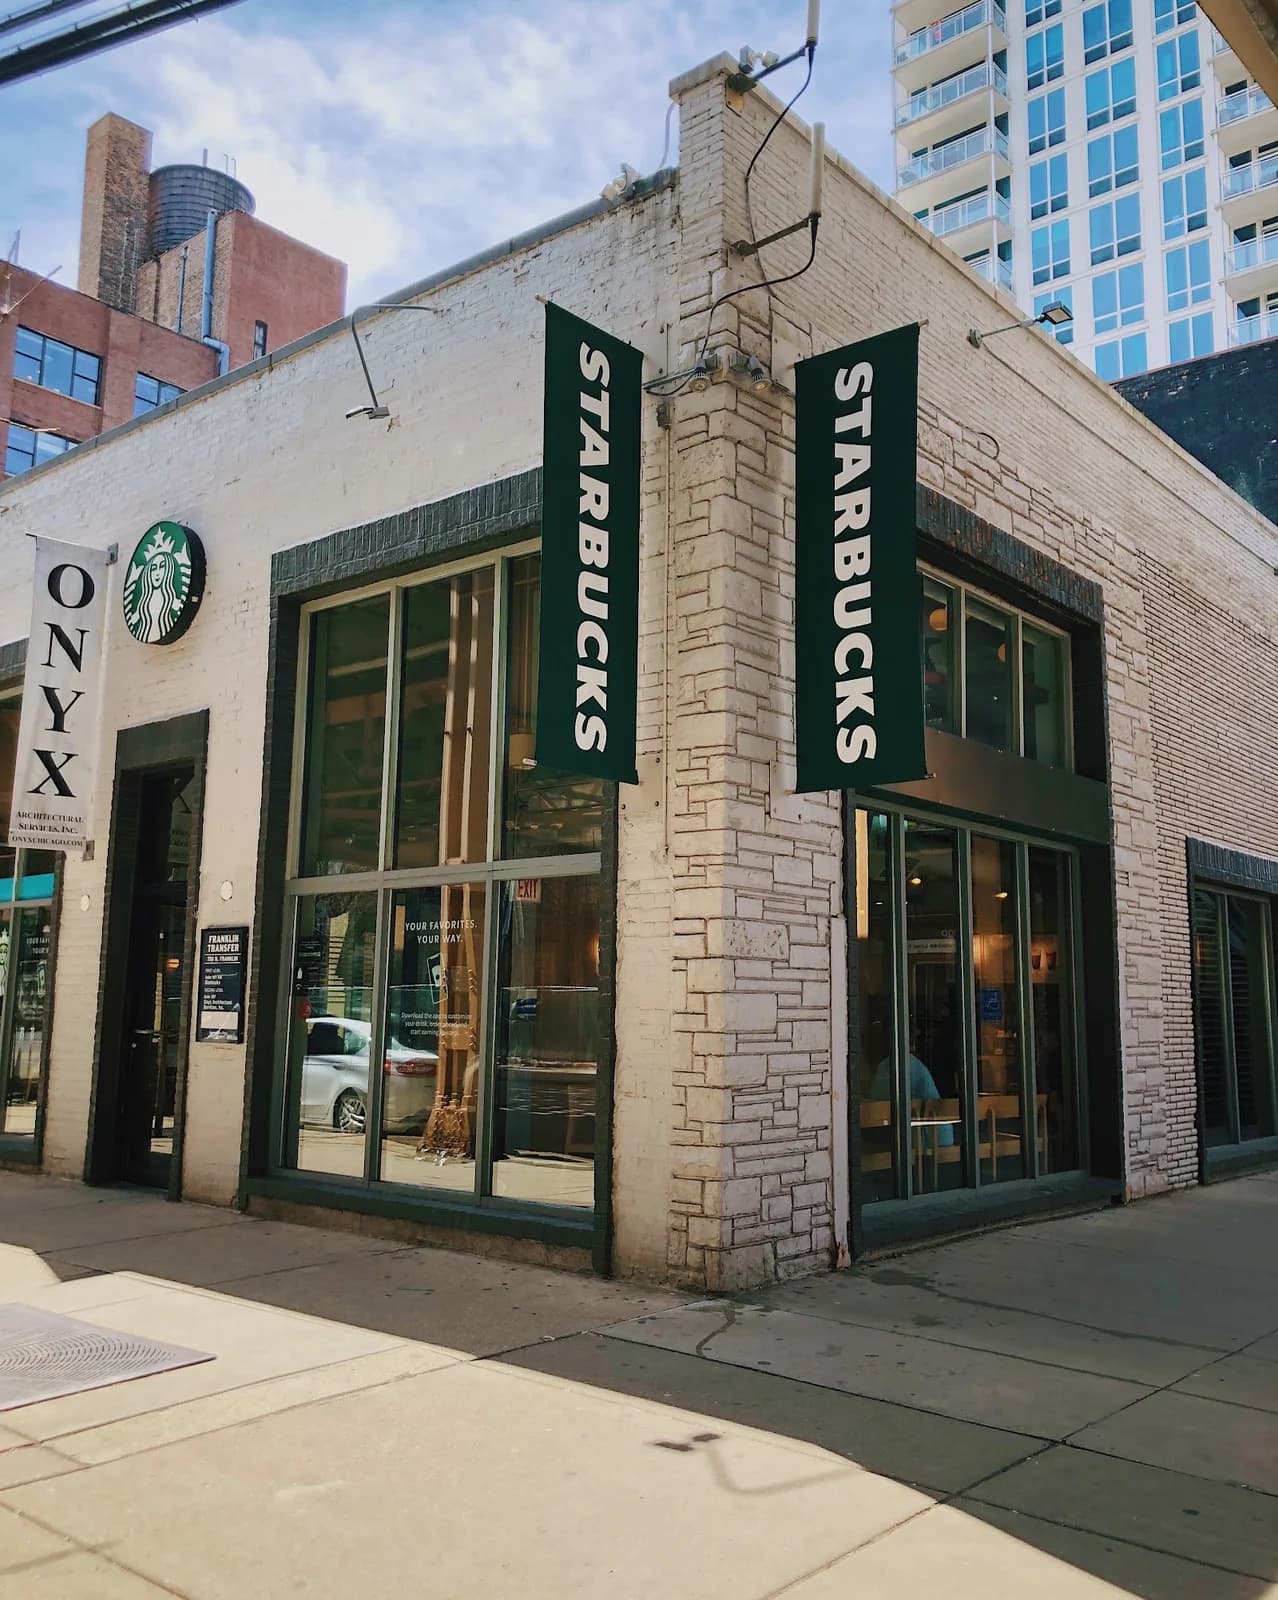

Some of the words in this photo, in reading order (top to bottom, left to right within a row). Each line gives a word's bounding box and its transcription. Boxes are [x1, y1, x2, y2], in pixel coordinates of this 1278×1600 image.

[574, 340, 610, 753] STARBUCKS
[832, 361, 877, 764] STARBUCKS
[26, 563, 95, 798] ONYX
[16, 811, 84, 823] ARCHITECTURAL
[61, 825, 78, 834] INC.
[517, 880, 537, 899] EXIT
[405, 921, 427, 931] YOUR
[429, 919, 478, 931] FAVORITES.
[208, 934, 239, 944] FRANKLIN
[417, 935, 439, 944] YOUR
[441, 934, 463, 944] WAY.
[207, 943, 240, 953] TRANSFER
[401, 1011, 423, 1019] Download
